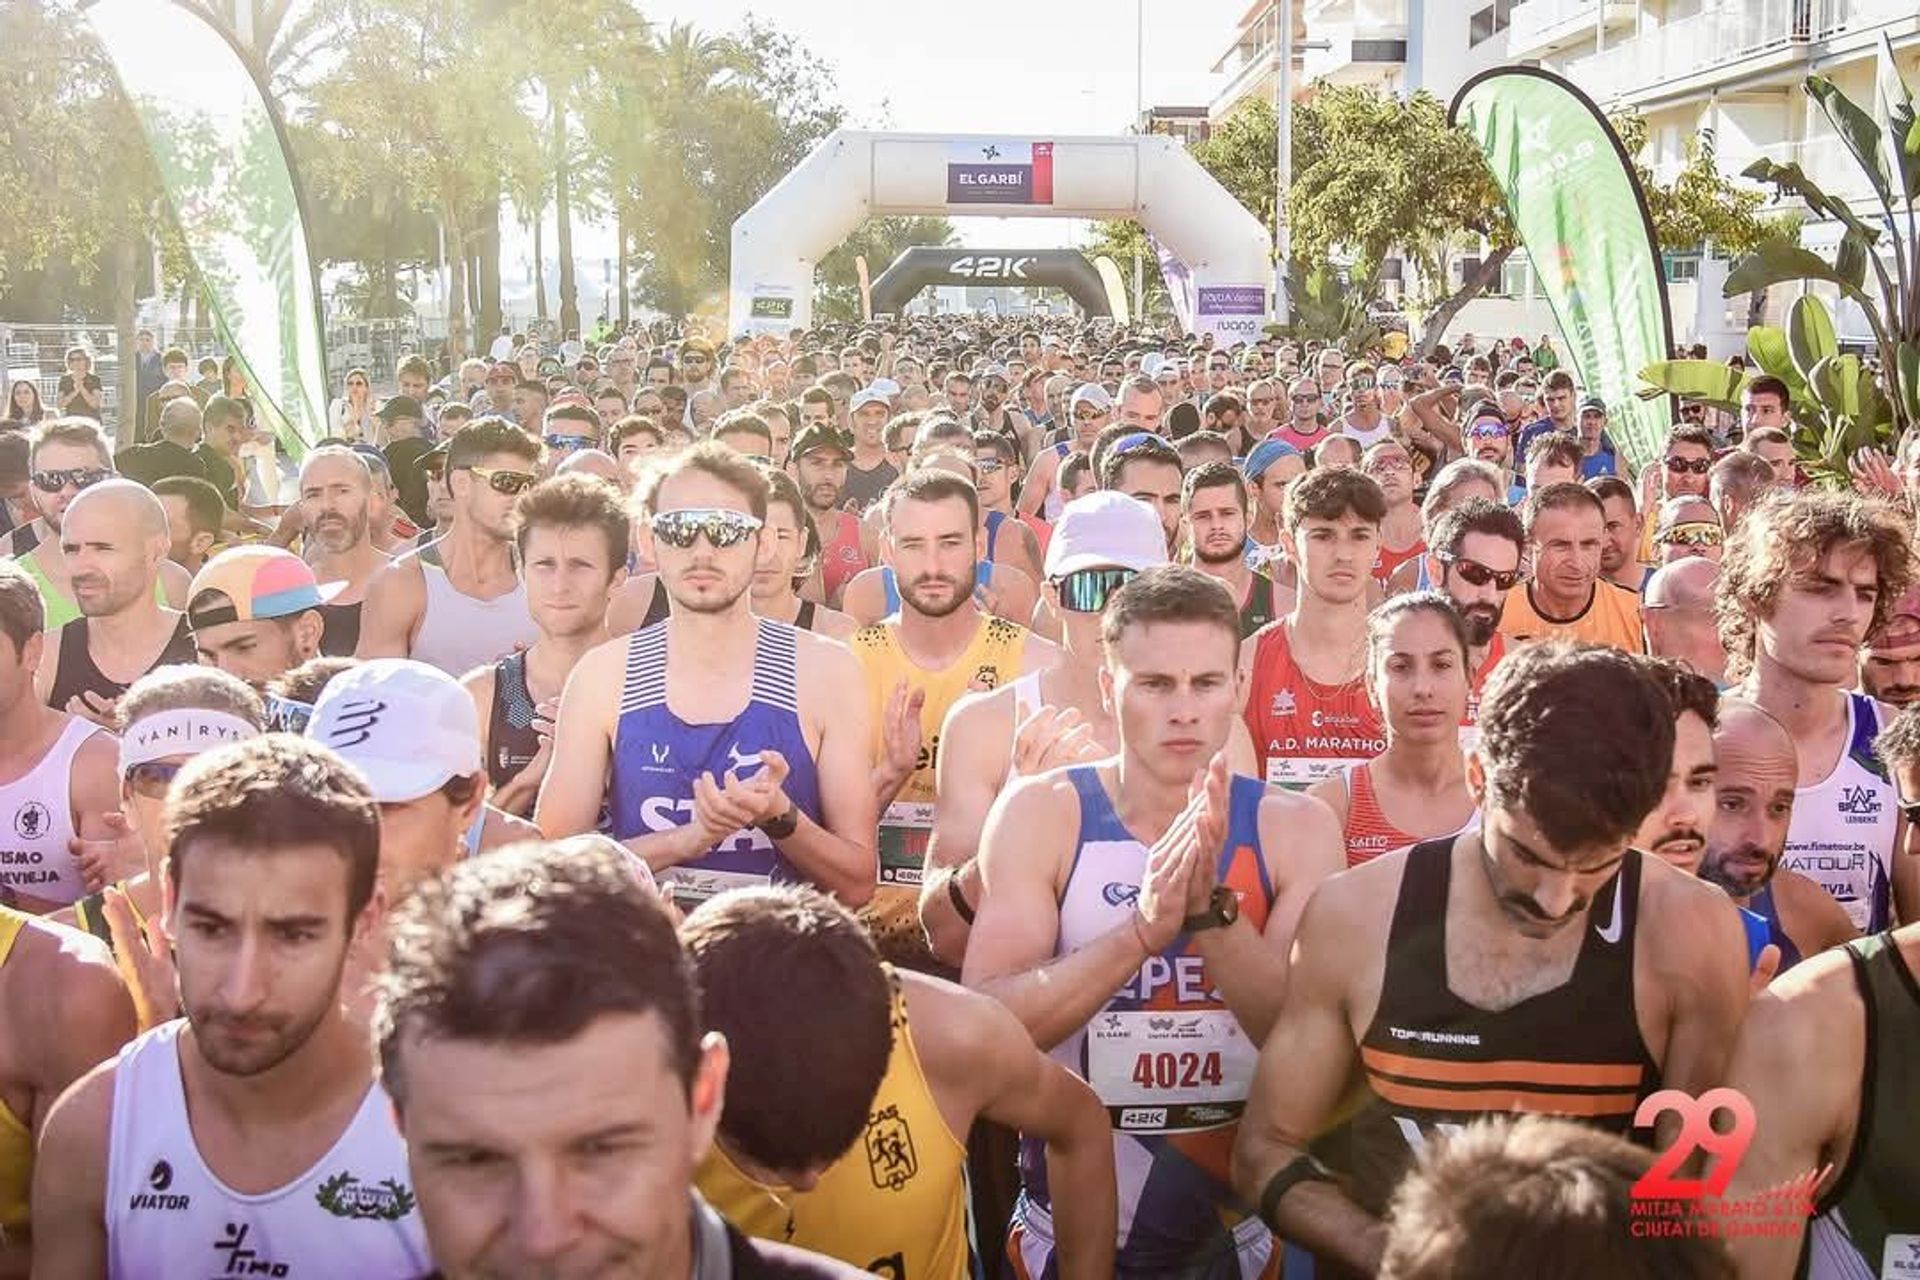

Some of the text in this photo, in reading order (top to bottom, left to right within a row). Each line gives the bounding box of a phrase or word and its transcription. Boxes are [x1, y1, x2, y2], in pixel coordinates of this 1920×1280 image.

[959, 170, 1024, 186] EL GARBÍ
[948, 255, 1029, 279] 42K
[138, 725, 179, 746] VAN
[1131, 1051, 1223, 1090] 4024
[1123, 1111, 1164, 1125] 42K
[130, 1193, 190, 1211] VIATOR
